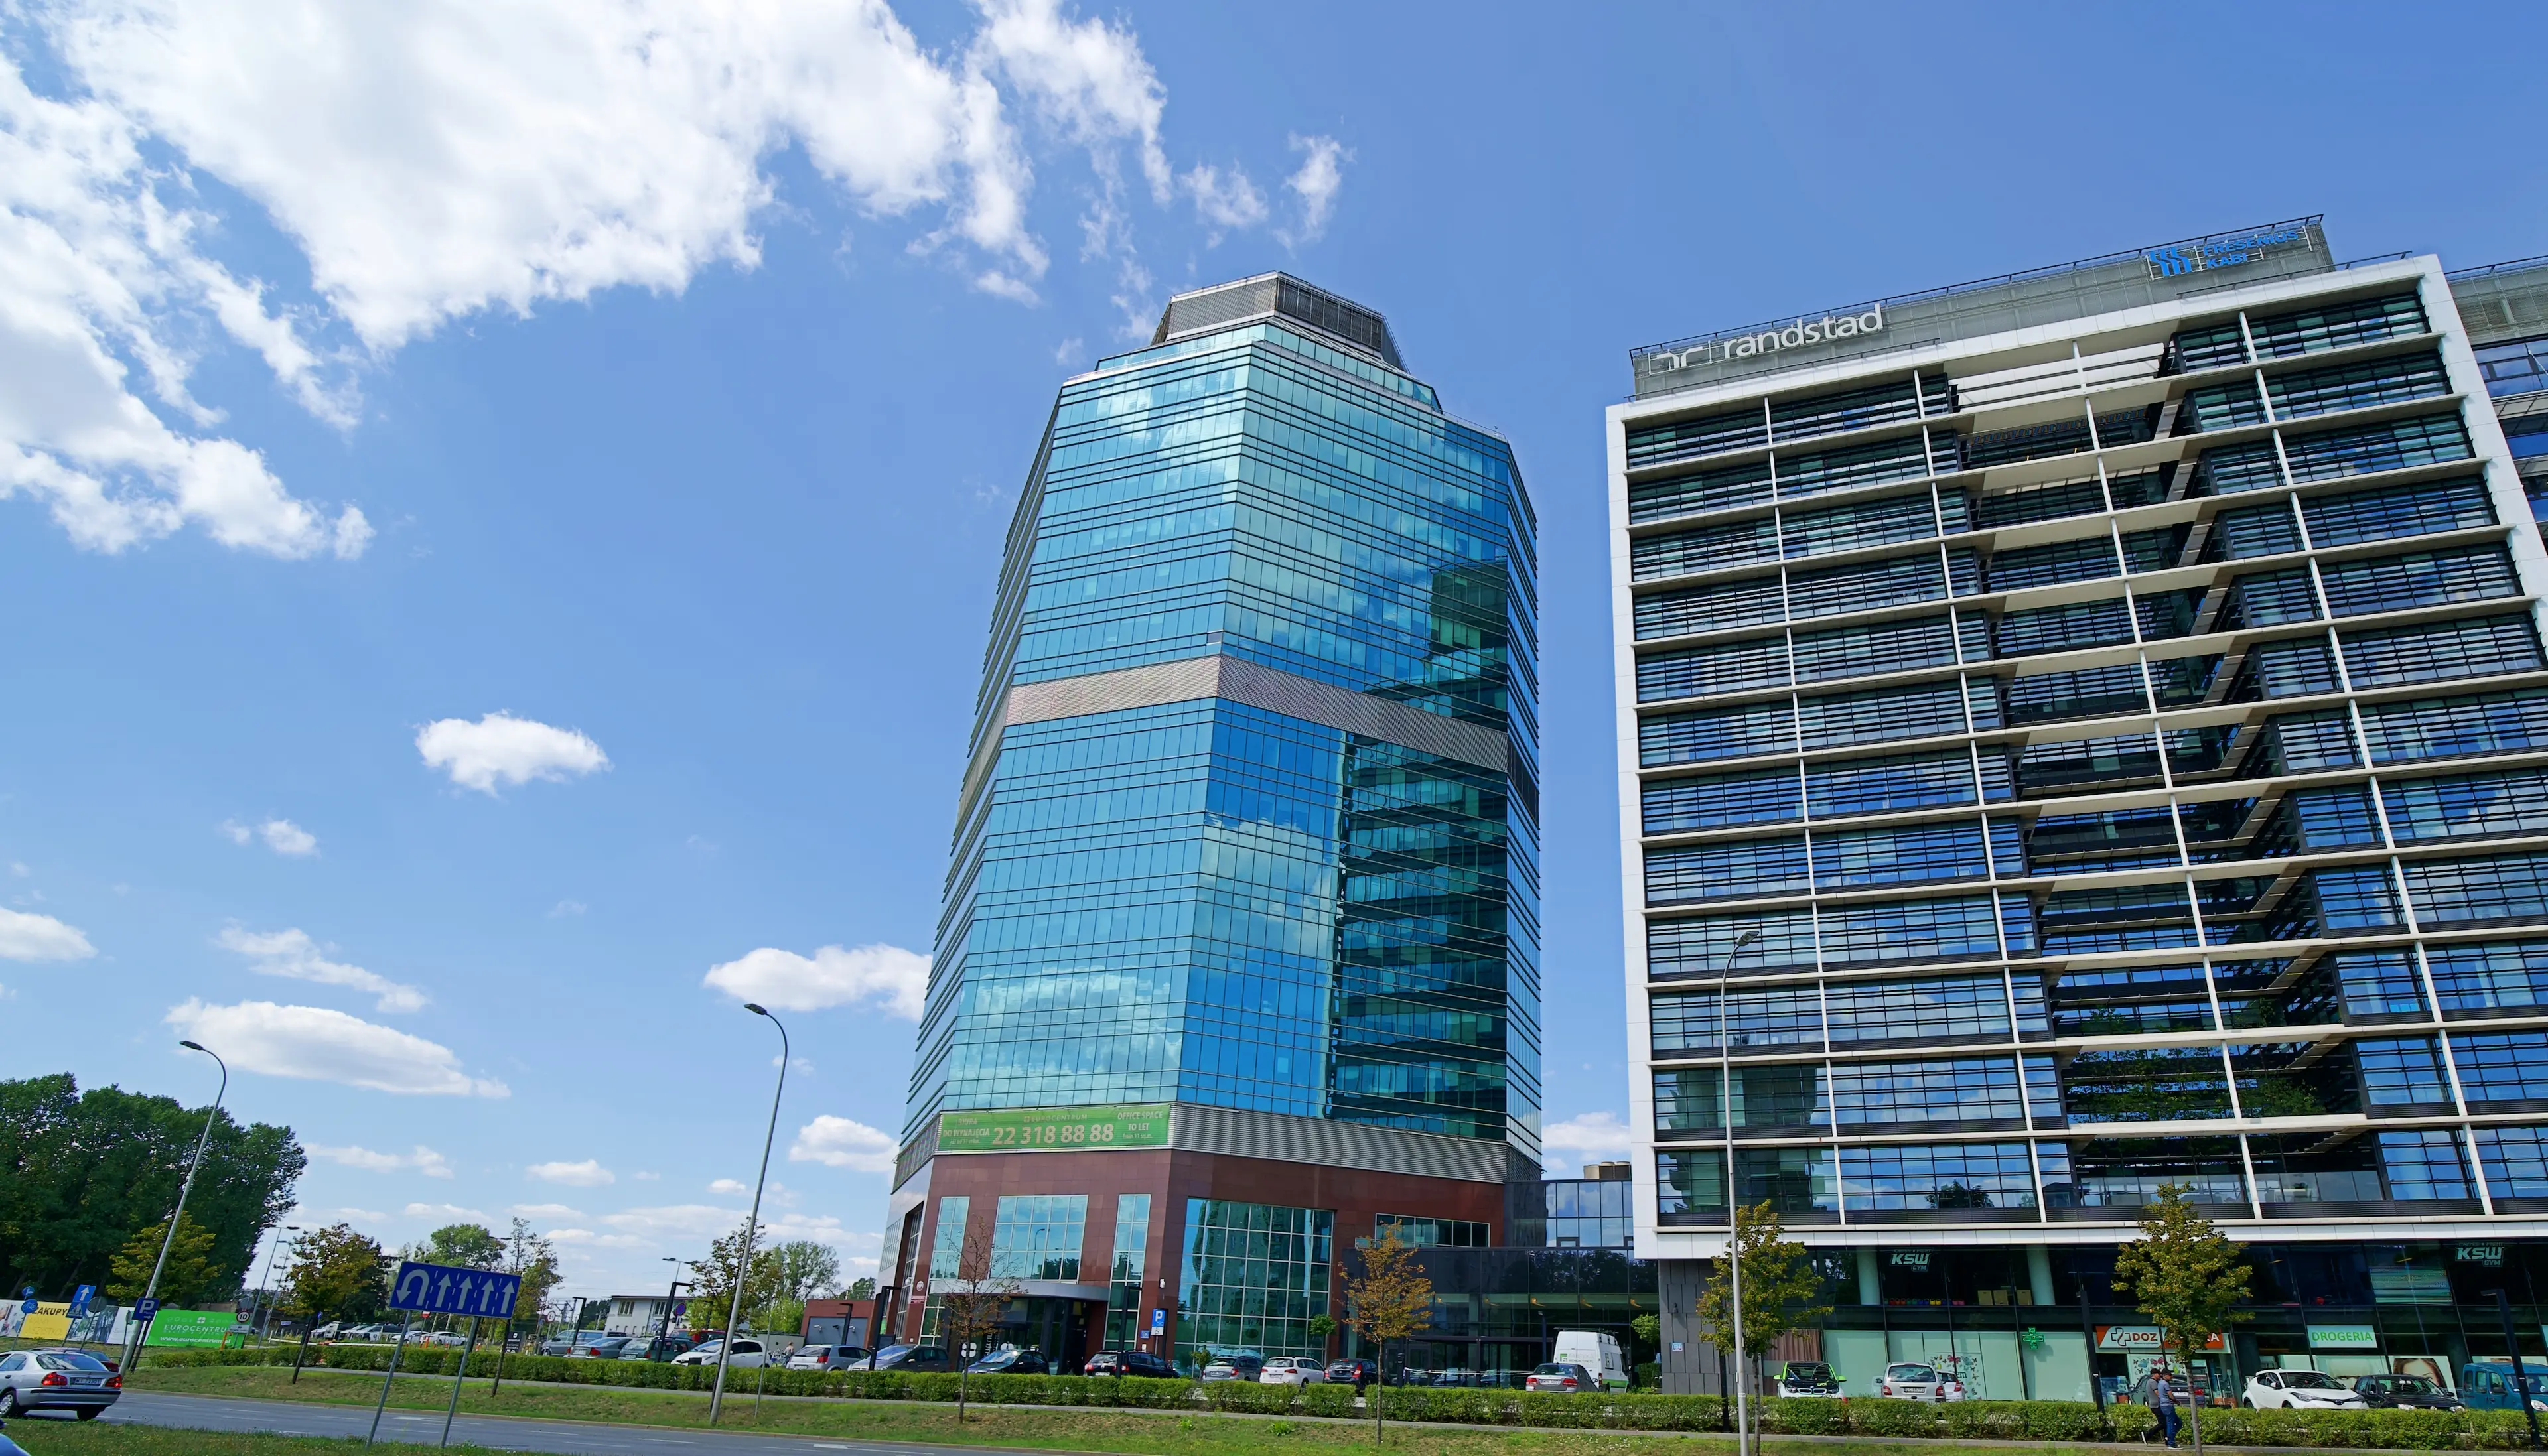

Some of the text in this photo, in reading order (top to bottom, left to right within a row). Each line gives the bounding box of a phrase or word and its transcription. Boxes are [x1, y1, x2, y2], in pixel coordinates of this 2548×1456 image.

[2204, 231, 2299, 256] FRESENIUS
[2206, 253, 2247, 269] KABI
[1724, 304, 1884, 359] randstad
[992, 1124, 1113, 1145] 22 318 88 88
[1890, 1253, 1932, 1264] KSW
[2455, 1247, 2505, 1260] KSW
[139, 1300, 155, 1314] P
[1155, 1311, 1163, 1322] P
[164, 1324, 228, 1333] EUROCENTRU
[2132, 1333, 2158, 1341] DOZ
[2311, 1331, 2373, 1341] DROGERIA
